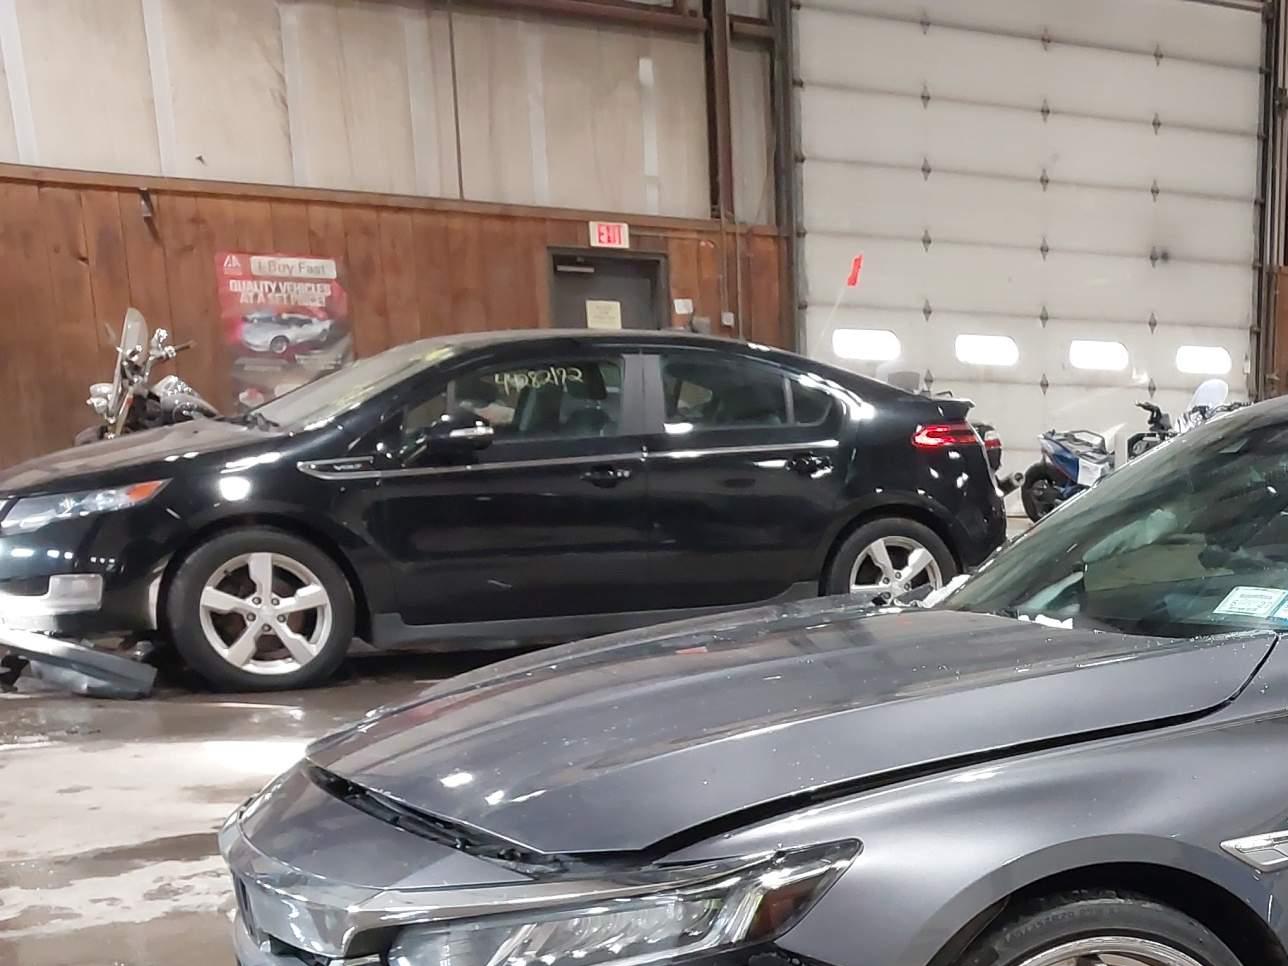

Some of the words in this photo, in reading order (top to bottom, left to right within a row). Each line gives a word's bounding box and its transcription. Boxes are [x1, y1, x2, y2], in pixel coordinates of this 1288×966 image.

[297, 263, 326, 274] Fast
[229, 279, 277, 293] QUALITY
[278, 282, 331, 296] VEHICLES
